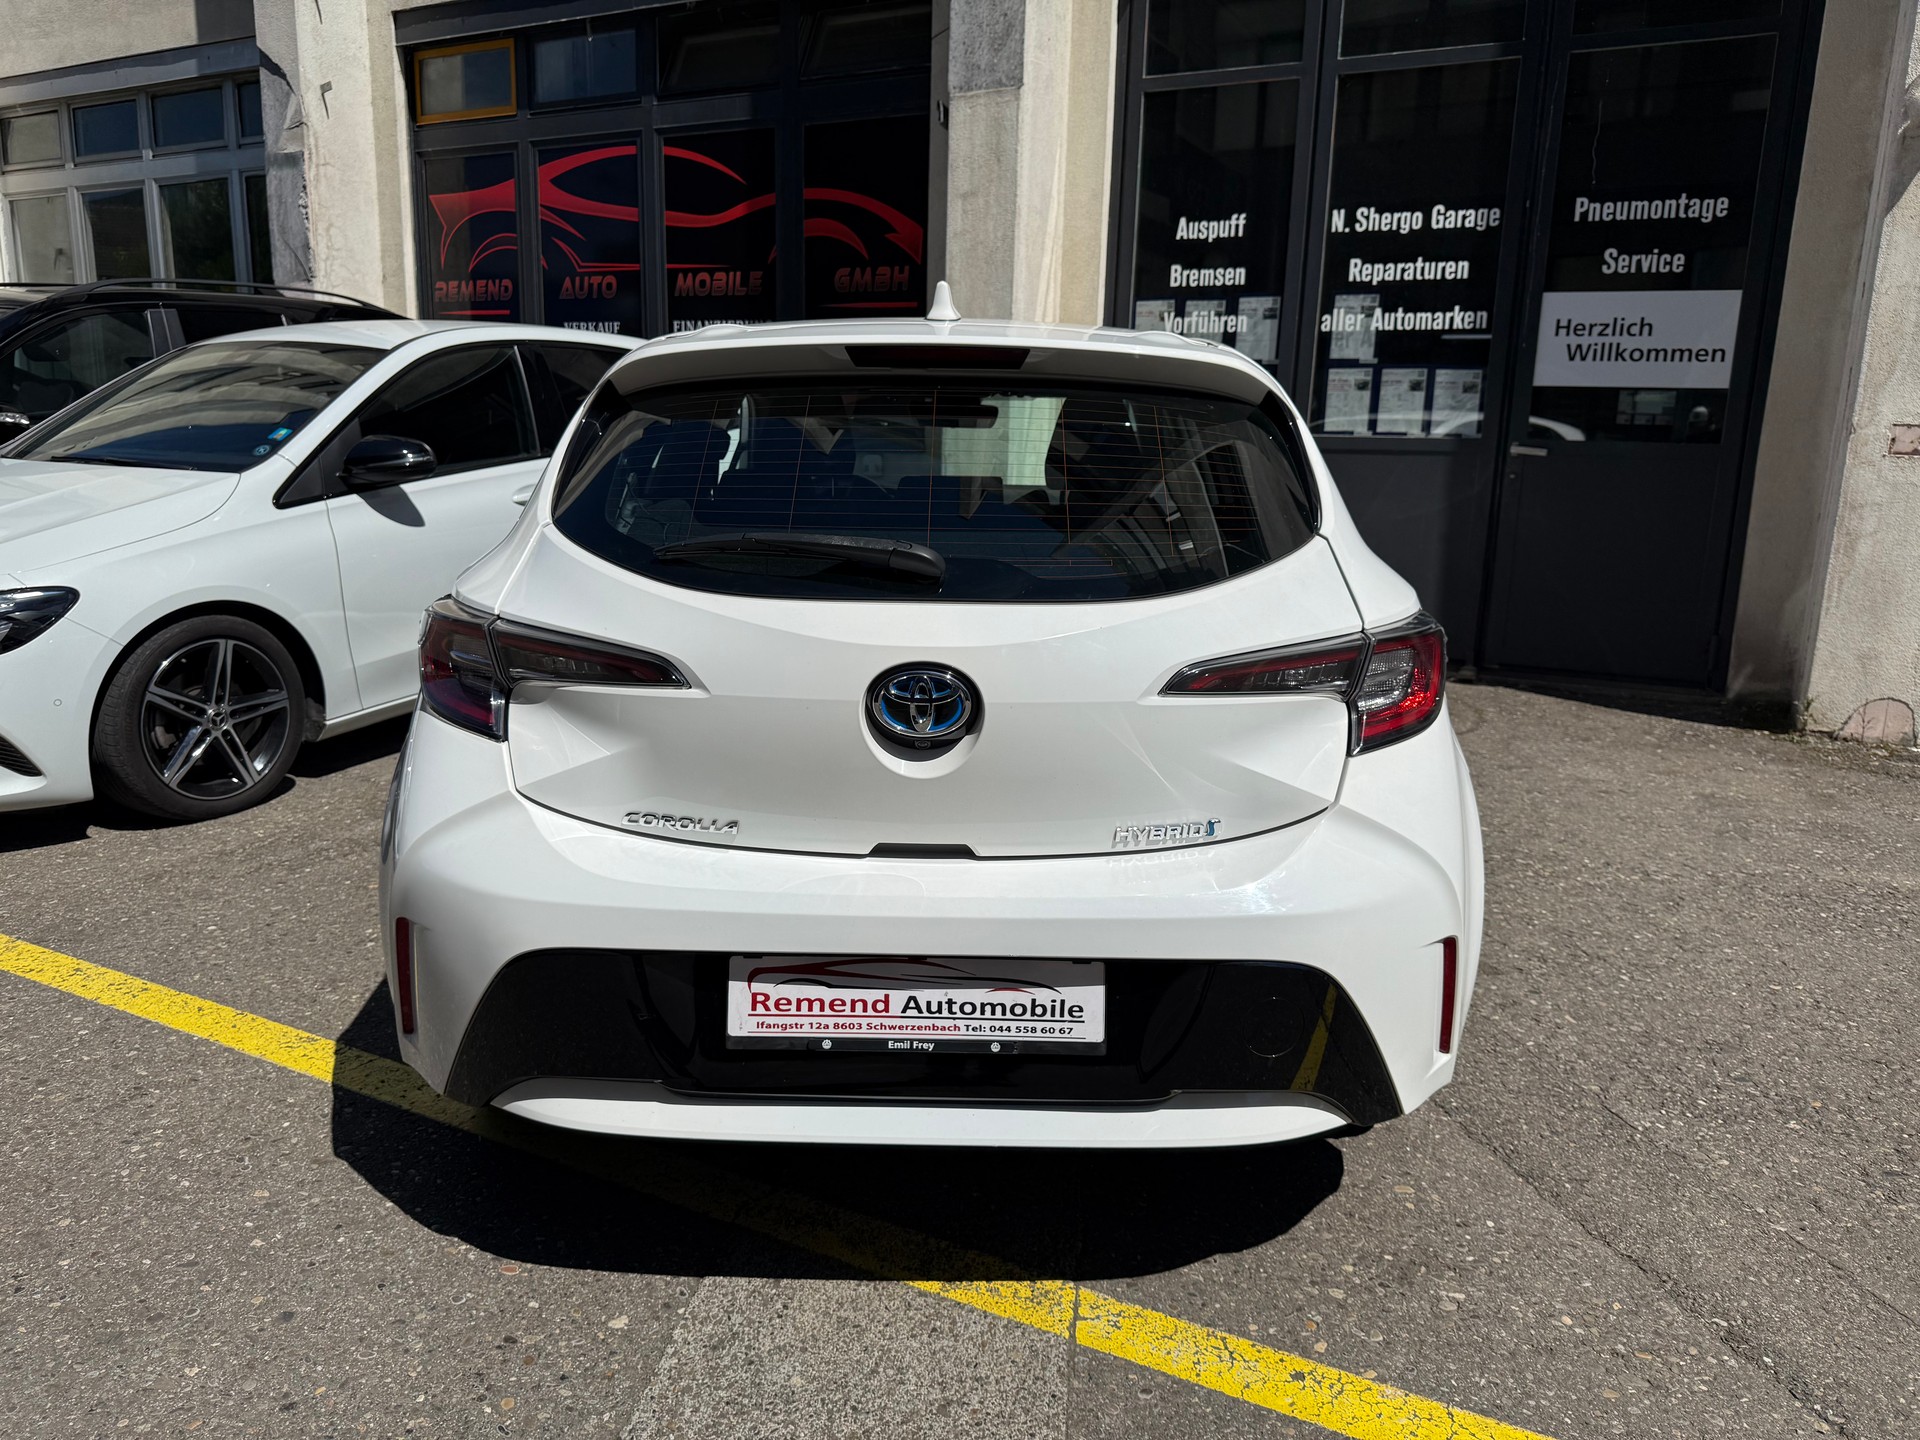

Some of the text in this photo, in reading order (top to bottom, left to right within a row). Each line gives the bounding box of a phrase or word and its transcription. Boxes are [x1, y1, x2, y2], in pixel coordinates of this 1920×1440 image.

[1331, 204, 1500, 234] N. Shergo Garage
[1573, 193, 1729, 223] Pneumontage
[1175, 213, 1247, 242] Auspuff
[1348, 257, 1470, 286] Reparaturen
[1601, 248, 1686, 275] Service
[434, 265, 911, 302] REMEND AUTO MOBILE GMBH
[1169, 265, 1247, 288] Bremsen
[564, 321, 621, 335] VERKAUF
[1163, 311, 1248, 334] Vorführen
[1320, 305, 1488, 332] aller Automarken
[1554, 316, 1654, 338] Herzlich
[1566, 343, 1727, 363] Willkommen
[621, 811, 739, 835] COROLLA
[751, 992, 1085, 1018] Remend Automobile
[756, 1021, 1074, 1036] Ifangstr 12a 8603 Schwerzenbach Tel: 044 558 60 67
[888, 1040, 935, 1052] Emil Frey
